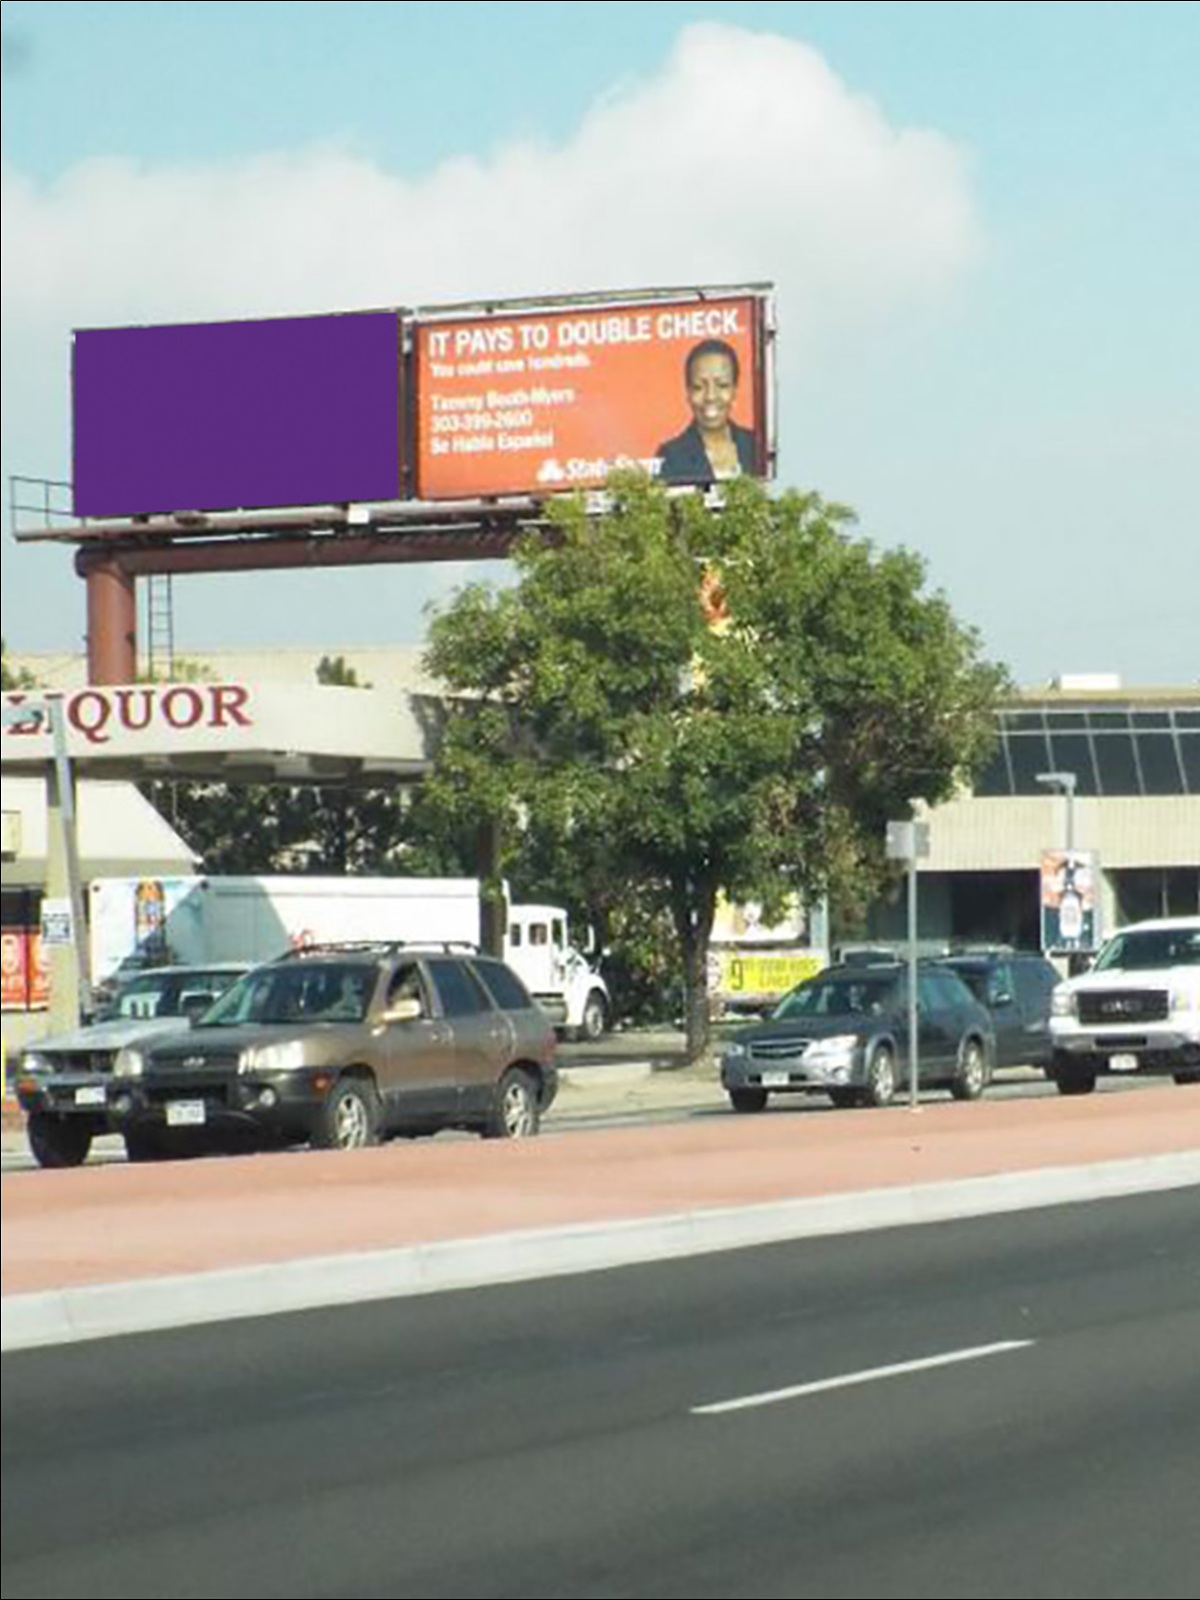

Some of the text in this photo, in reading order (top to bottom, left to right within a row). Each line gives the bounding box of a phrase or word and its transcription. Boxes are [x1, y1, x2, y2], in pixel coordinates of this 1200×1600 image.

[429, 332, 450, 358] IT
[455, 327, 514, 356] PAYS
[520, 323, 549, 350] TO
[557, 315, 652, 346] DOUBLE
